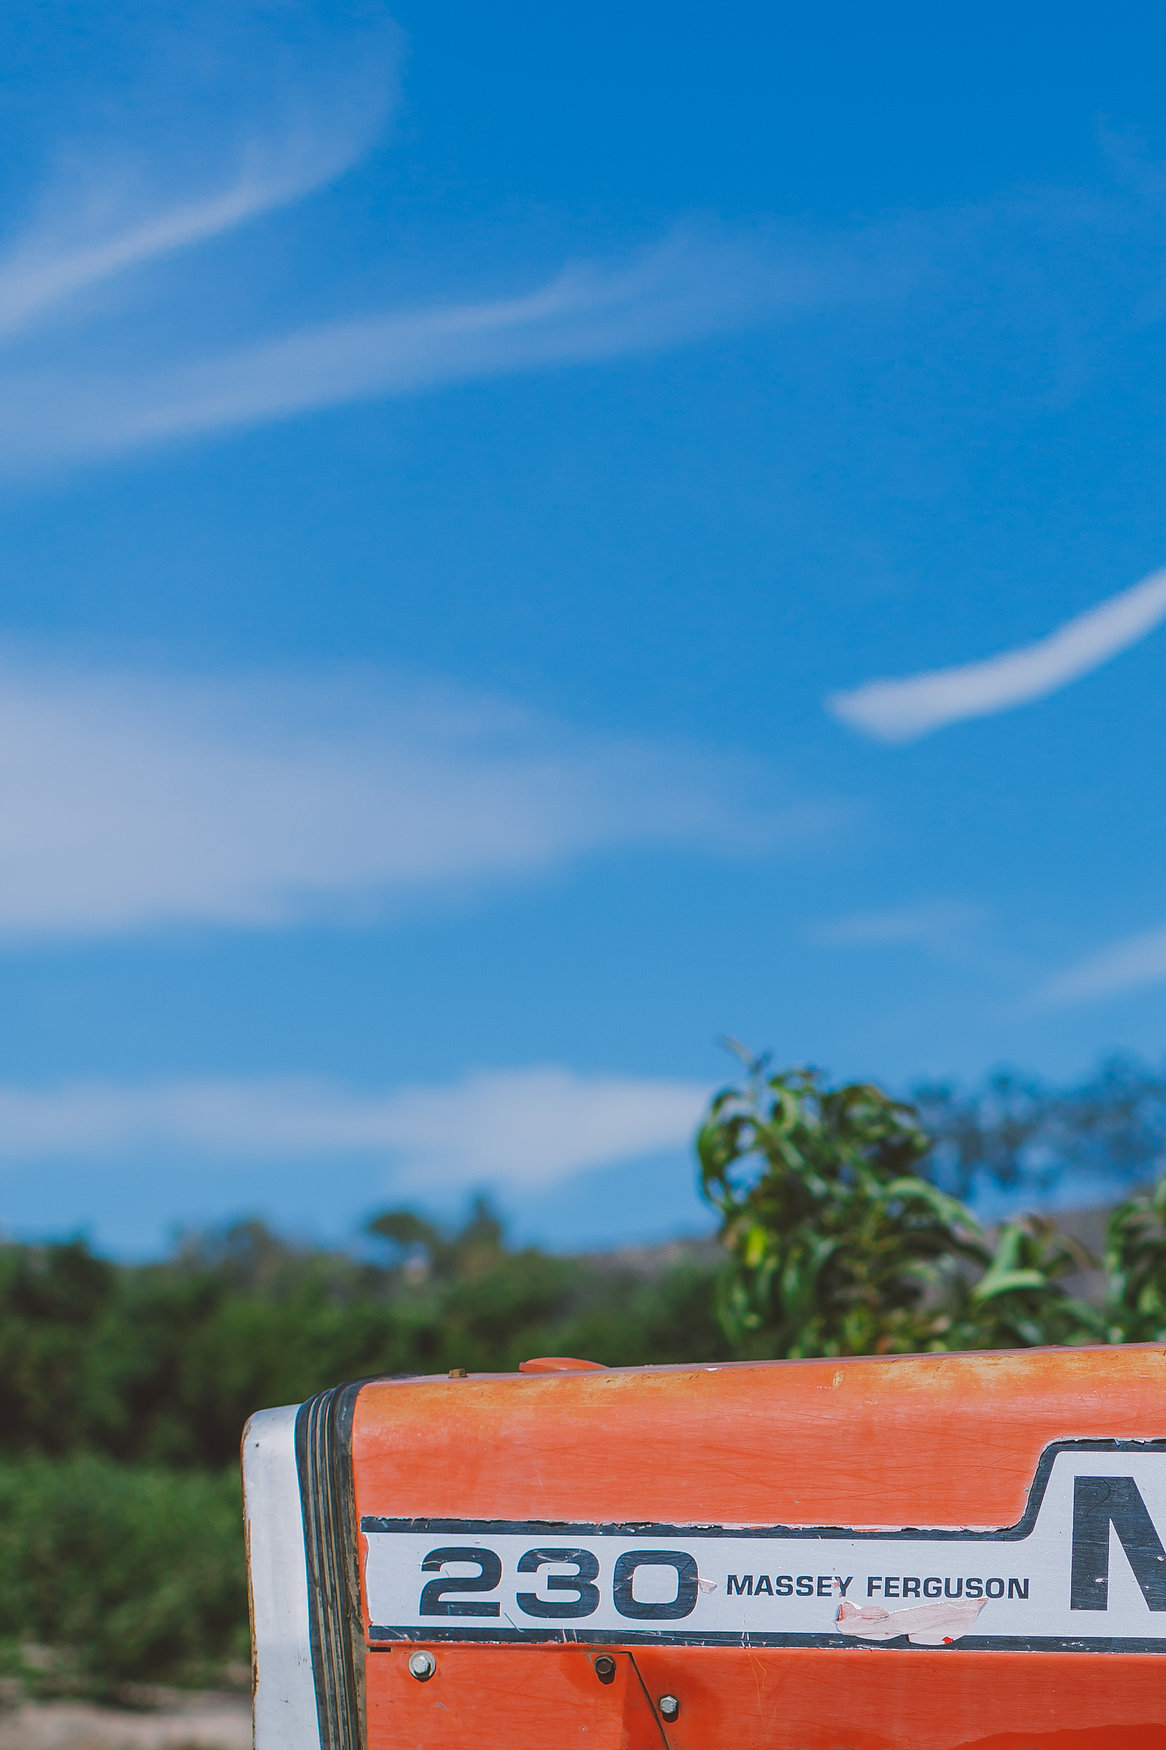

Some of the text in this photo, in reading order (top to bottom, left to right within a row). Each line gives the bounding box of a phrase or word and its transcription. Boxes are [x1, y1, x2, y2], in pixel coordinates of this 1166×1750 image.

[419, 1547, 1030, 1620] 230 MASSEY FERGUSON
